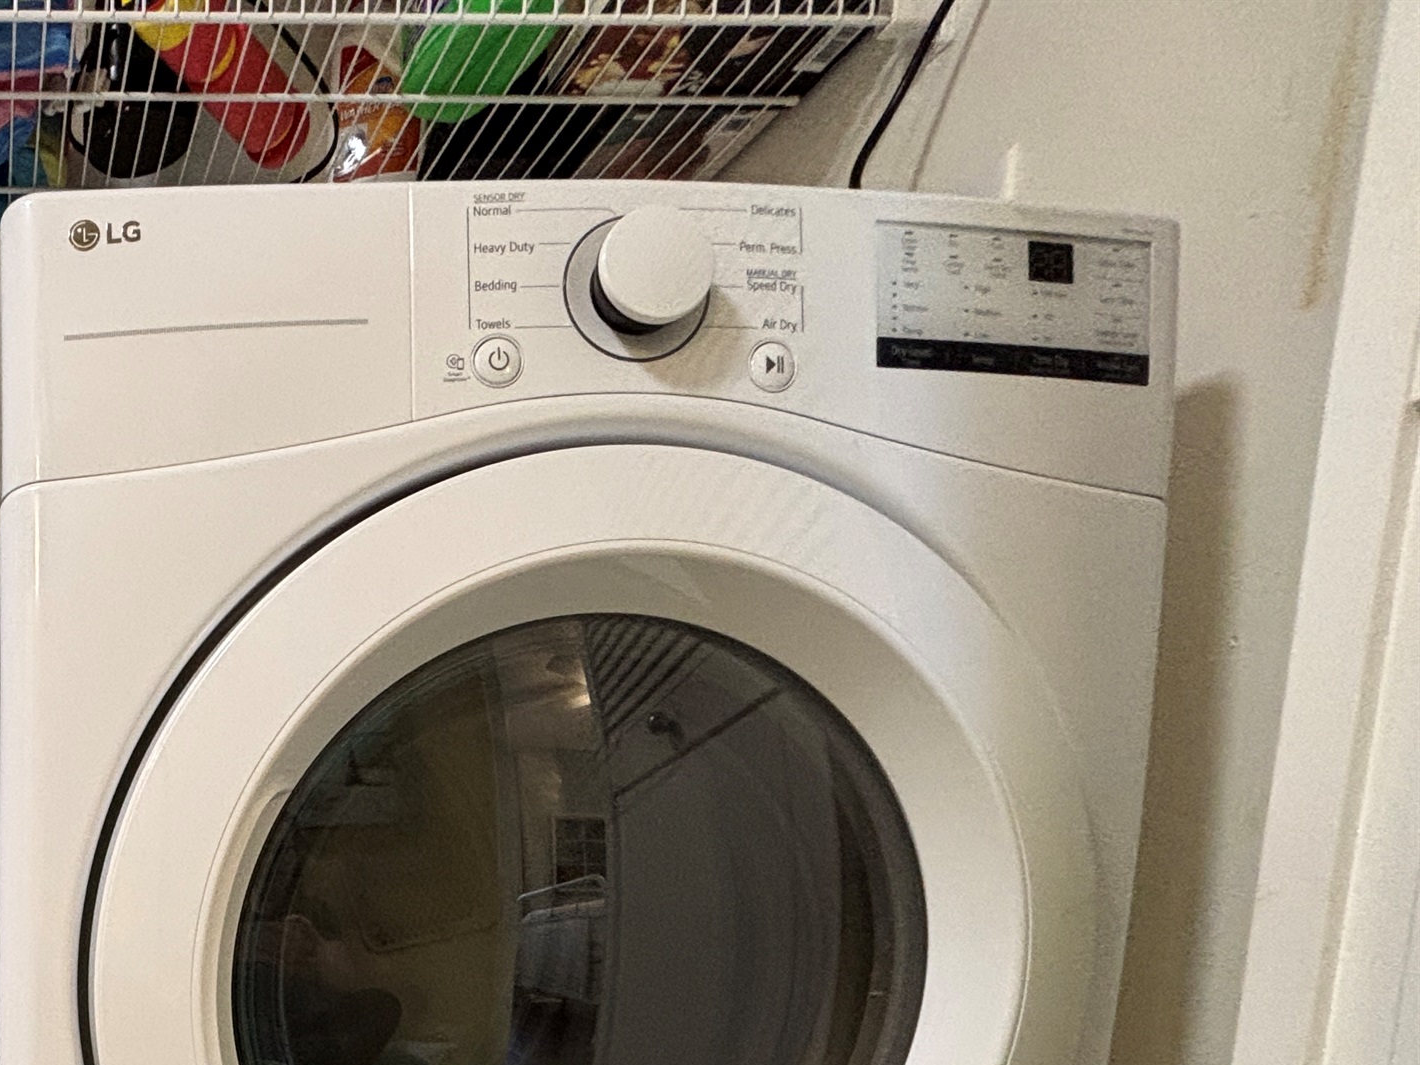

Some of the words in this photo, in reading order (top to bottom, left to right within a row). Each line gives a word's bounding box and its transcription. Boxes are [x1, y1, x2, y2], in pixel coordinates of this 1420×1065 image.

[473, 193, 506, 202] SENSOR
[508, 192, 525, 201] DRY
[473, 205, 511, 217] Normal
[751, 205, 796, 217] Delicates
[106, 221, 141, 244] LG
[474, 243, 506, 255] Heavy
[509, 241, 535, 255] Duty
[770, 242, 797, 255] Press
[746, 268, 778, 278] MANUAL
[781, 269, 797, 279] DRY
[475, 280, 517, 293] Bedding
[747, 280, 777, 292] Speed
[780, 281, 797, 295] Dry
[476, 318, 511, 330] Towels
[762, 318, 777, 330] Air
[780, 319, 797, 334] Dry
